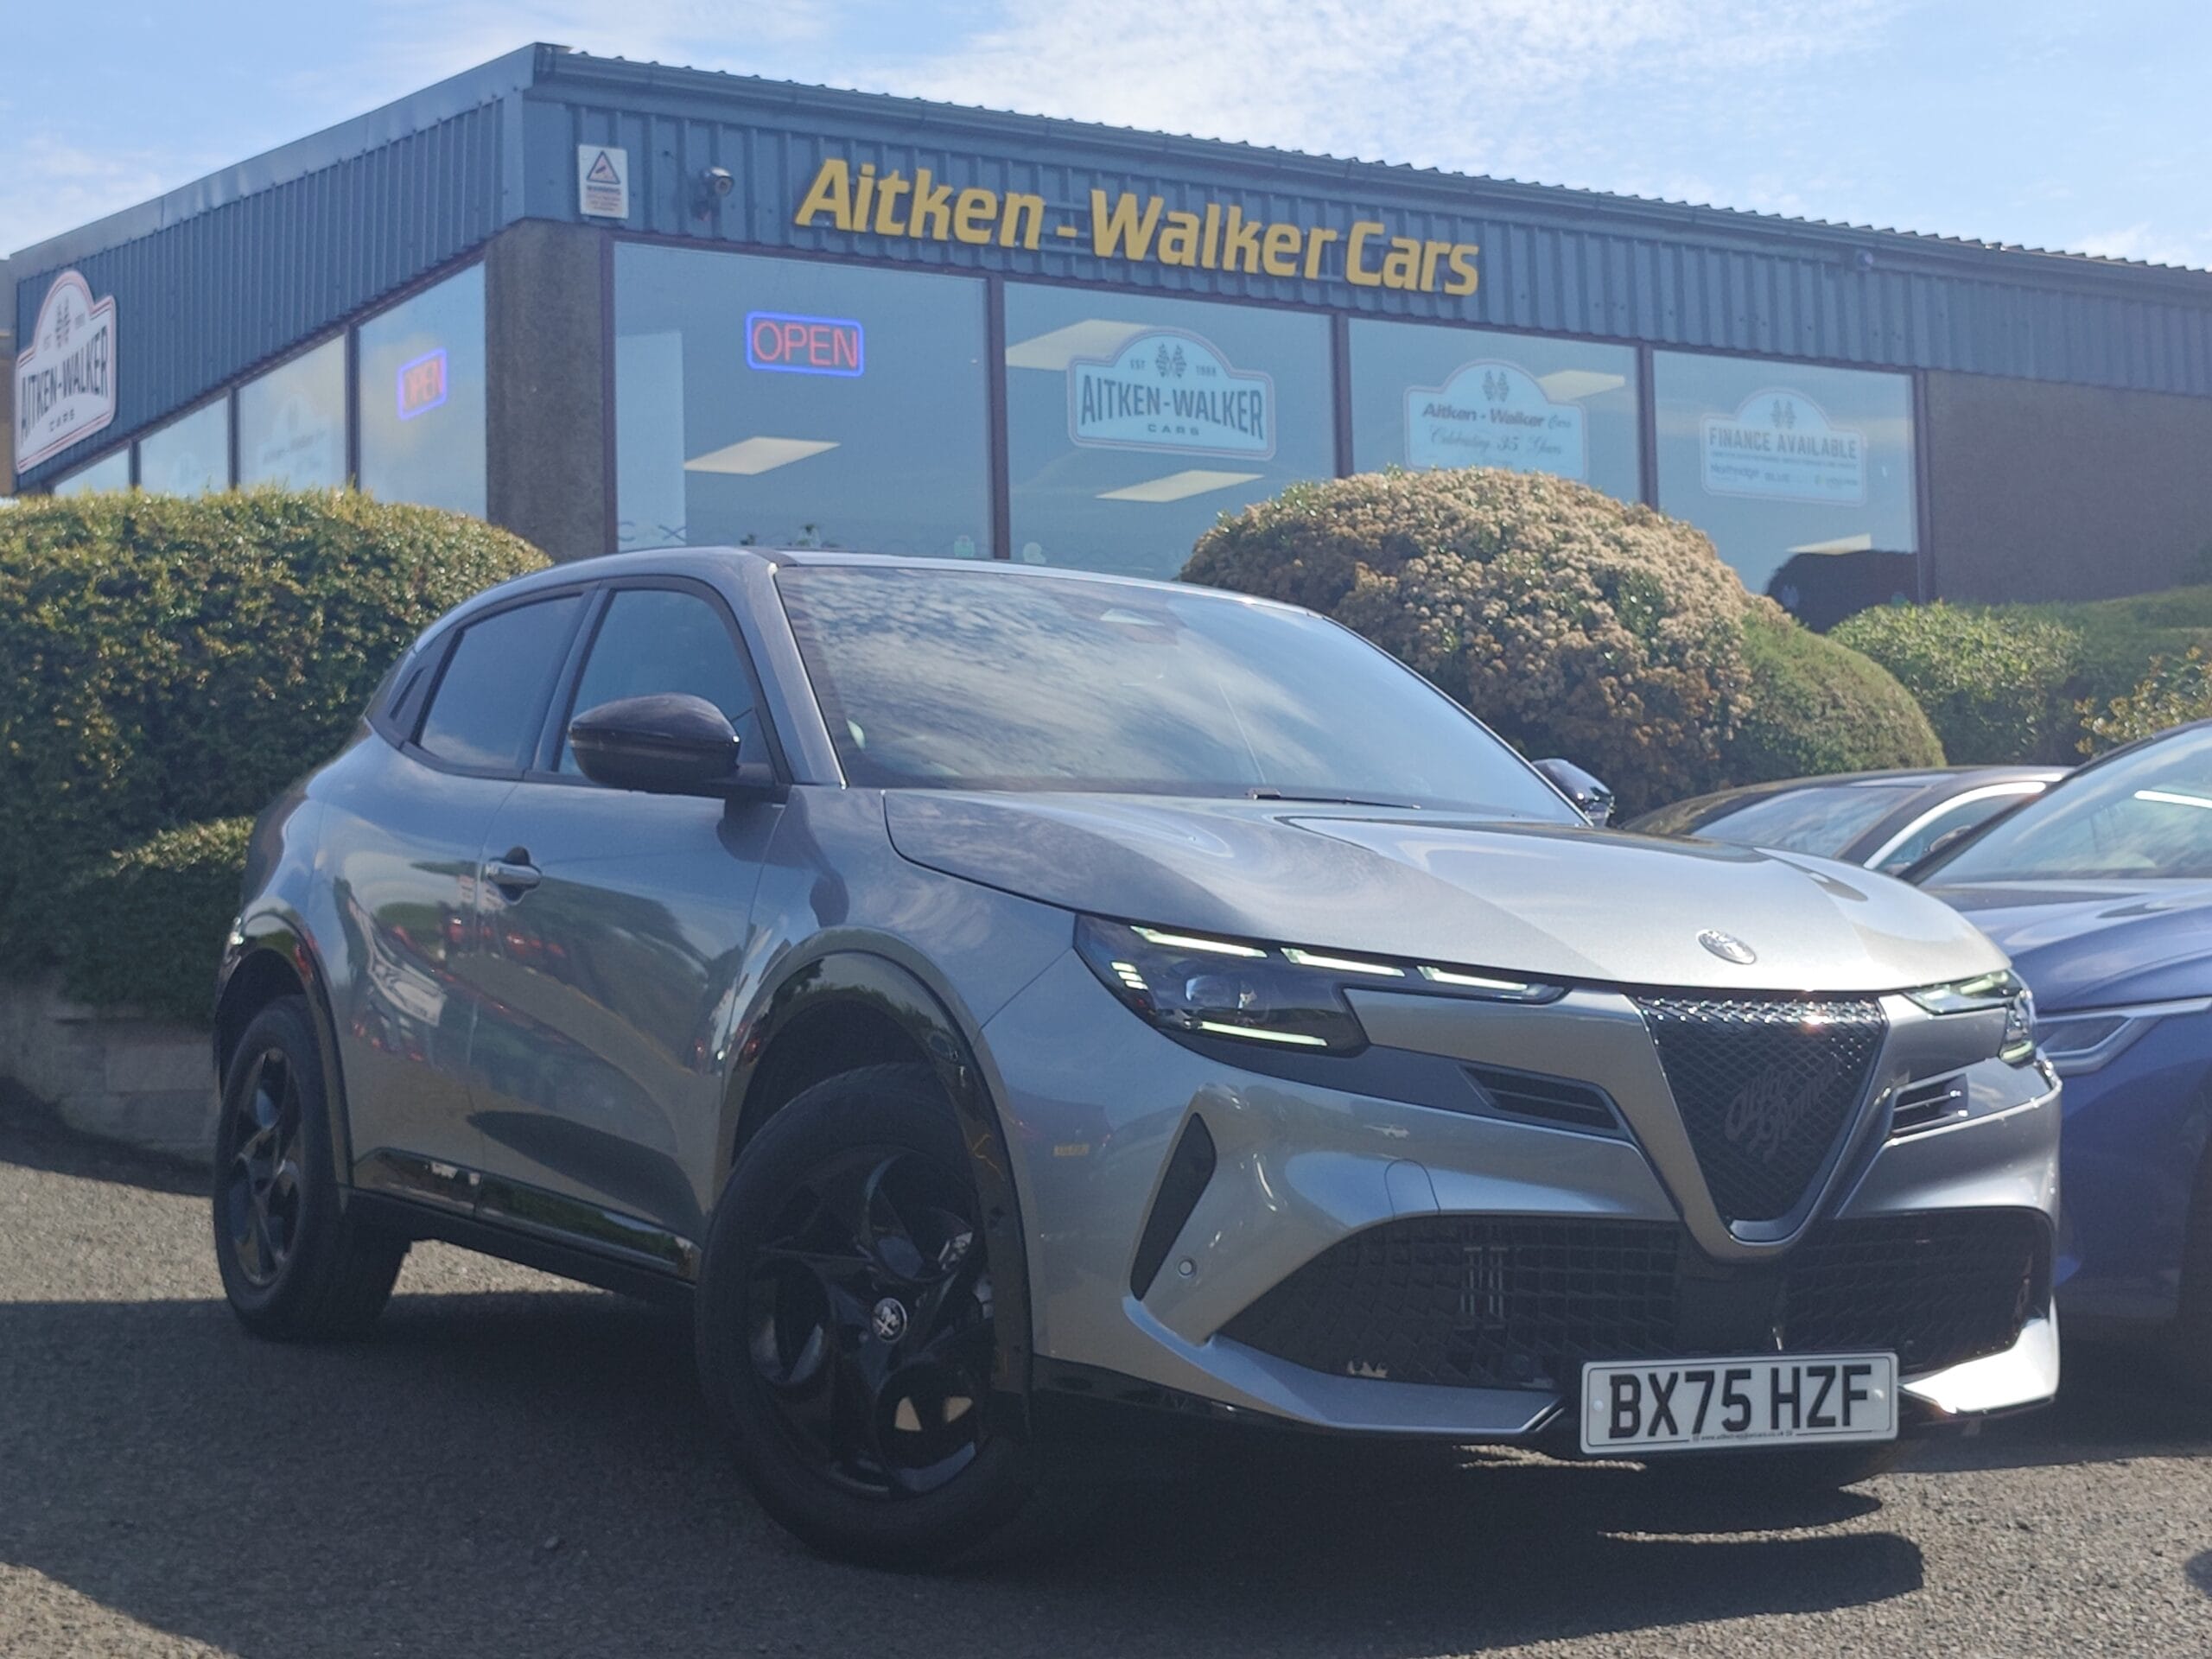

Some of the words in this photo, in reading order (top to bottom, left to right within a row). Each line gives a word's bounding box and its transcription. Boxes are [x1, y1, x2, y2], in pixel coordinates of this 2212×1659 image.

[795, 158, 1046, 250] Aitken
[1090, 188, 1338, 280] Walker
[1345, 220, 1479, 296] Cars
[752, 320, 859, 368] OPEN
[1081, 374, 1263, 441] AITKEN-WALKER
[1147, 423, 1200, 436] CARS
[1421, 403, 1478, 422] Aitken
[1490, 408, 1547, 428] Walker
[1708, 427, 1770, 452] FINANCE
[1777, 433, 1857, 460] AVAILABLE
[1608, 1368, 1751, 1440] BX75
[1770, 1364, 1872, 1430] HZF
